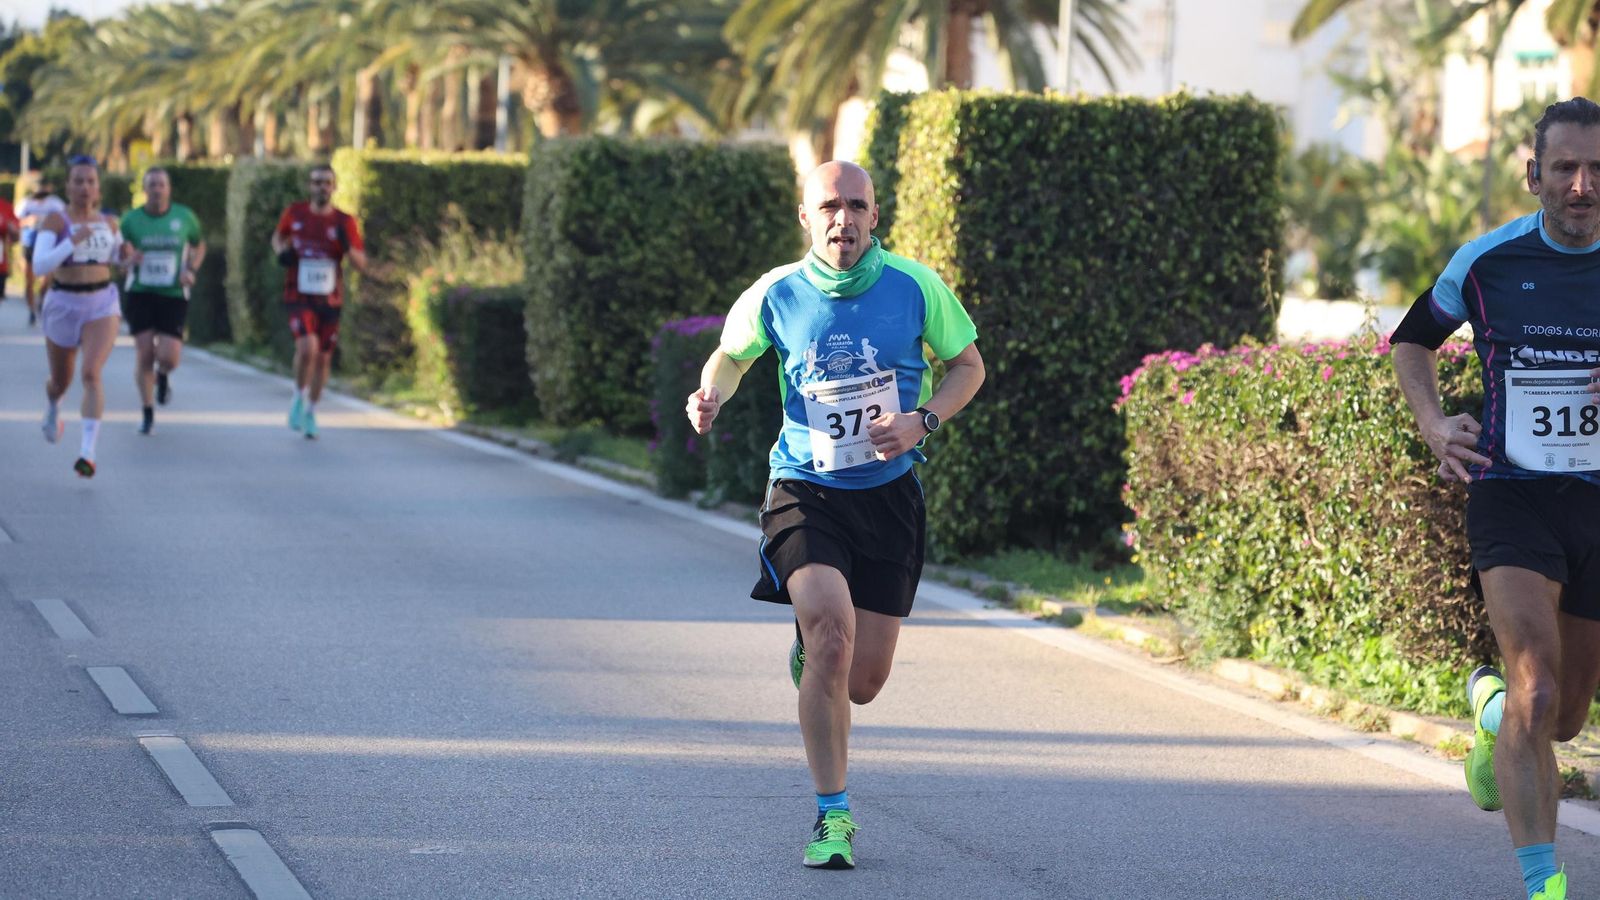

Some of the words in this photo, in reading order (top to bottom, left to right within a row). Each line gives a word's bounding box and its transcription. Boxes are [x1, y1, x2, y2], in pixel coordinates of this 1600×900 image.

[1522, 282, 1535, 290] OS
[1522, 325, 1562, 337] TOD@S
[1564, 327, 1573, 336] A
[1509, 344, 1600, 369] KINDE
[1532, 405, 1599, 437] 318
